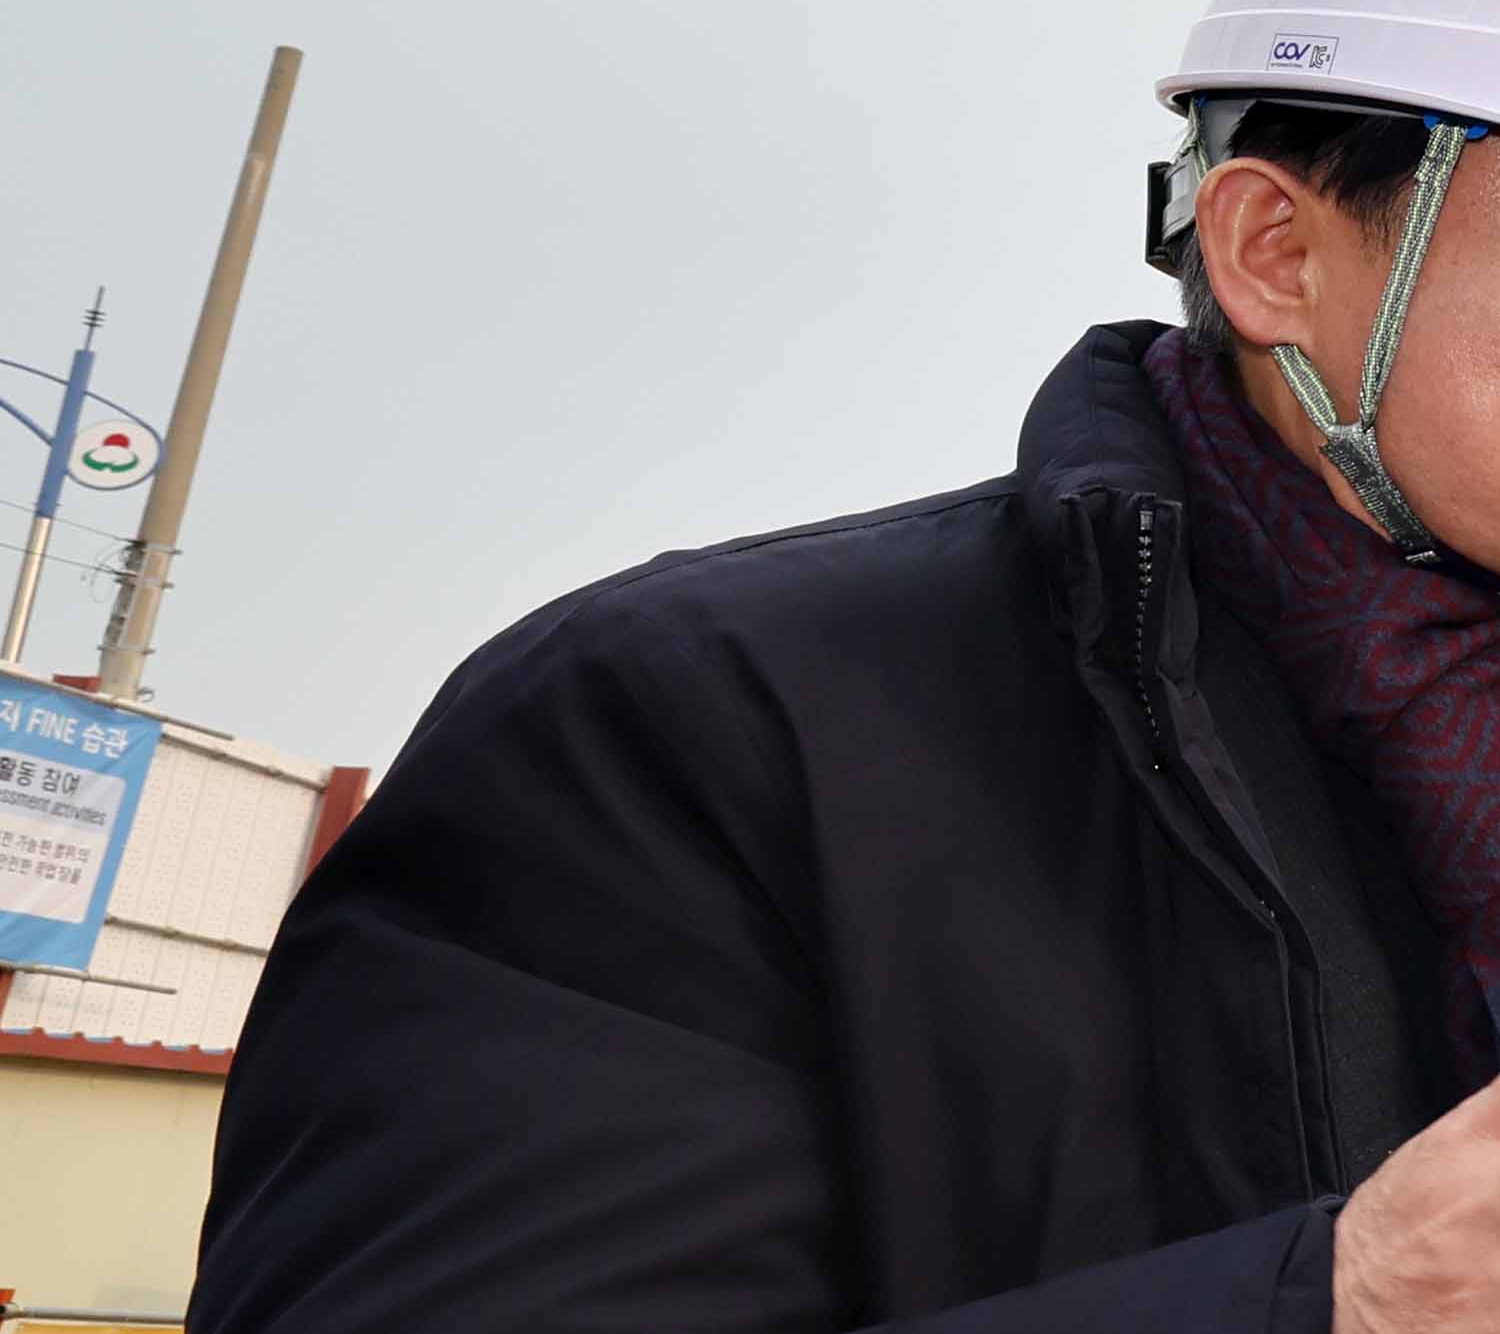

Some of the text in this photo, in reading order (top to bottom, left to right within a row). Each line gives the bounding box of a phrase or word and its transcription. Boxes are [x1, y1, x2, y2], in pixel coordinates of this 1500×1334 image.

[26, 707, 129, 758] FINE 습관
[42, 768, 80, 796] 참여
